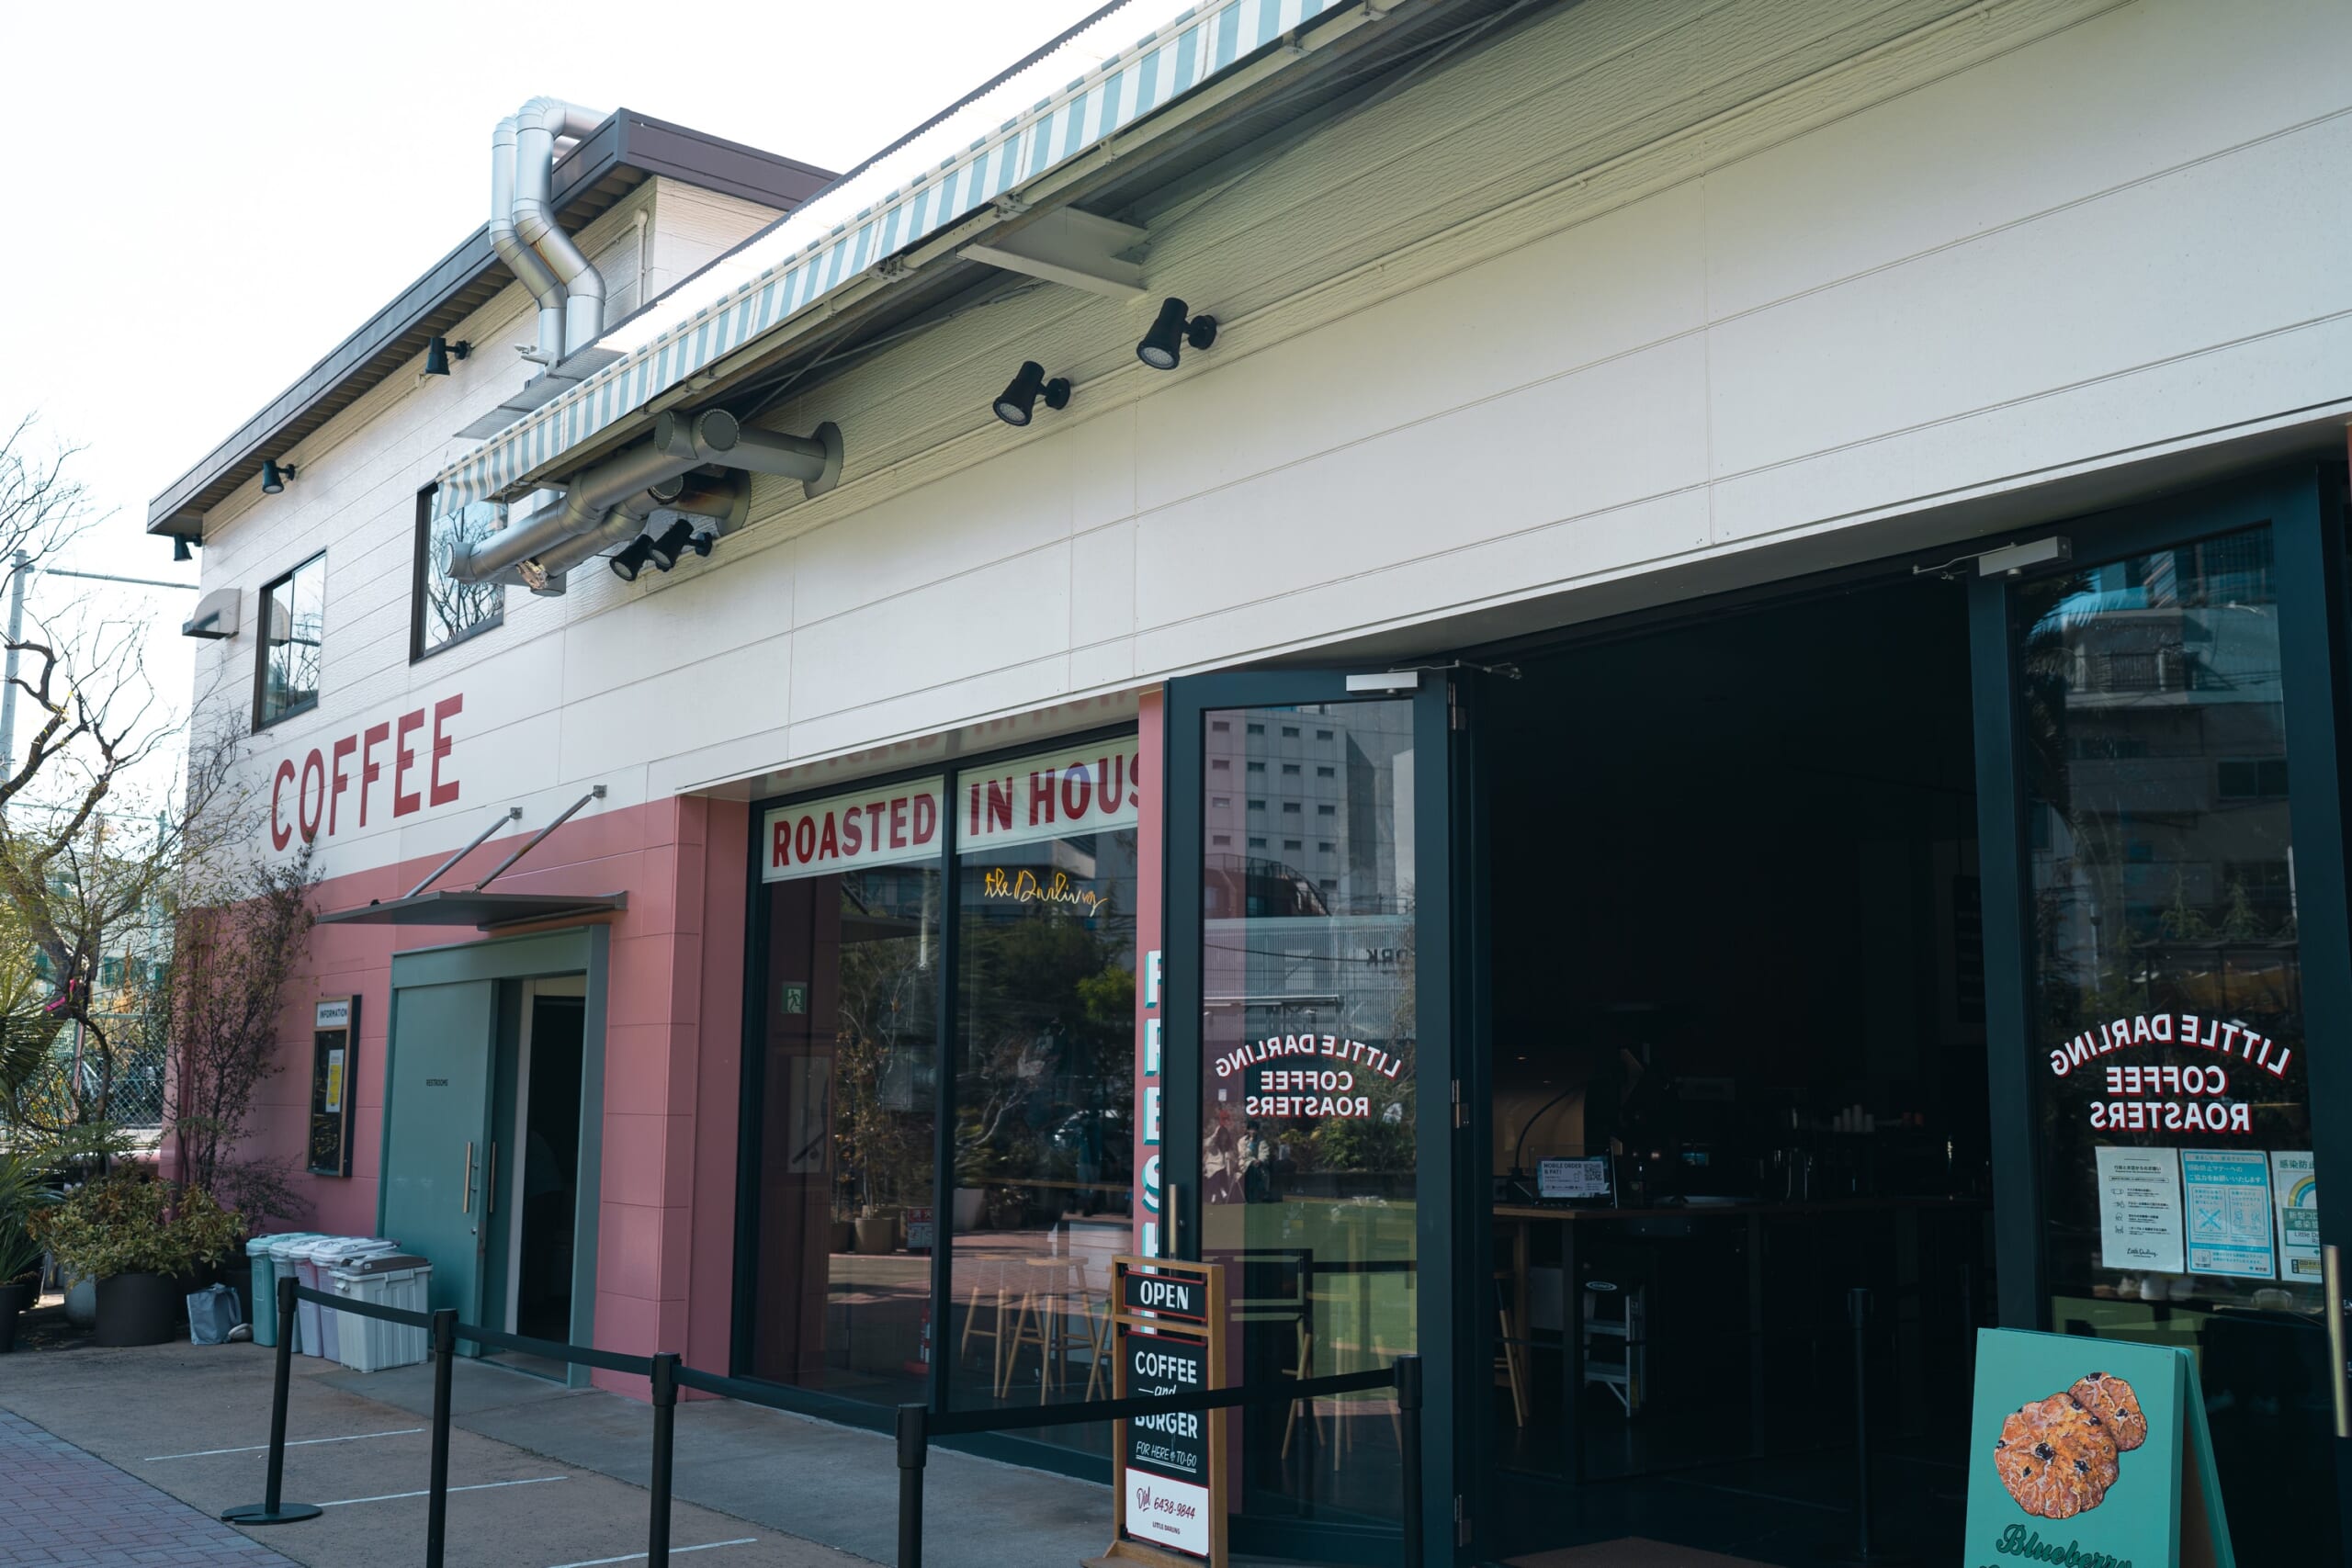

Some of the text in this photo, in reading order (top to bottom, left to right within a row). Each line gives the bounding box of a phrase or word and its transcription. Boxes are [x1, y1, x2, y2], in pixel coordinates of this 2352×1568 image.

[271, 693, 463, 852] COFFEE
[773, 793, 936, 868] ROASTED
[970, 776, 1013, 837] IN
[984, 867, 1013, 898] the
[320, 1008, 348, 1019] INFORMATION
[1139, 1280, 1190, 1311] OPEN
[1135, 1350, 1197, 1384] COFFEE
[1154, 1384, 1177, 1397] and
[1136, 1440, 1150, 1456] FOR
[1151, 1444, 1170, 1461] HERE
[1153, 1495, 1196, 1520] 6438-9844
[1152, 1521, 1181, 1536] LITTLE DARLING
